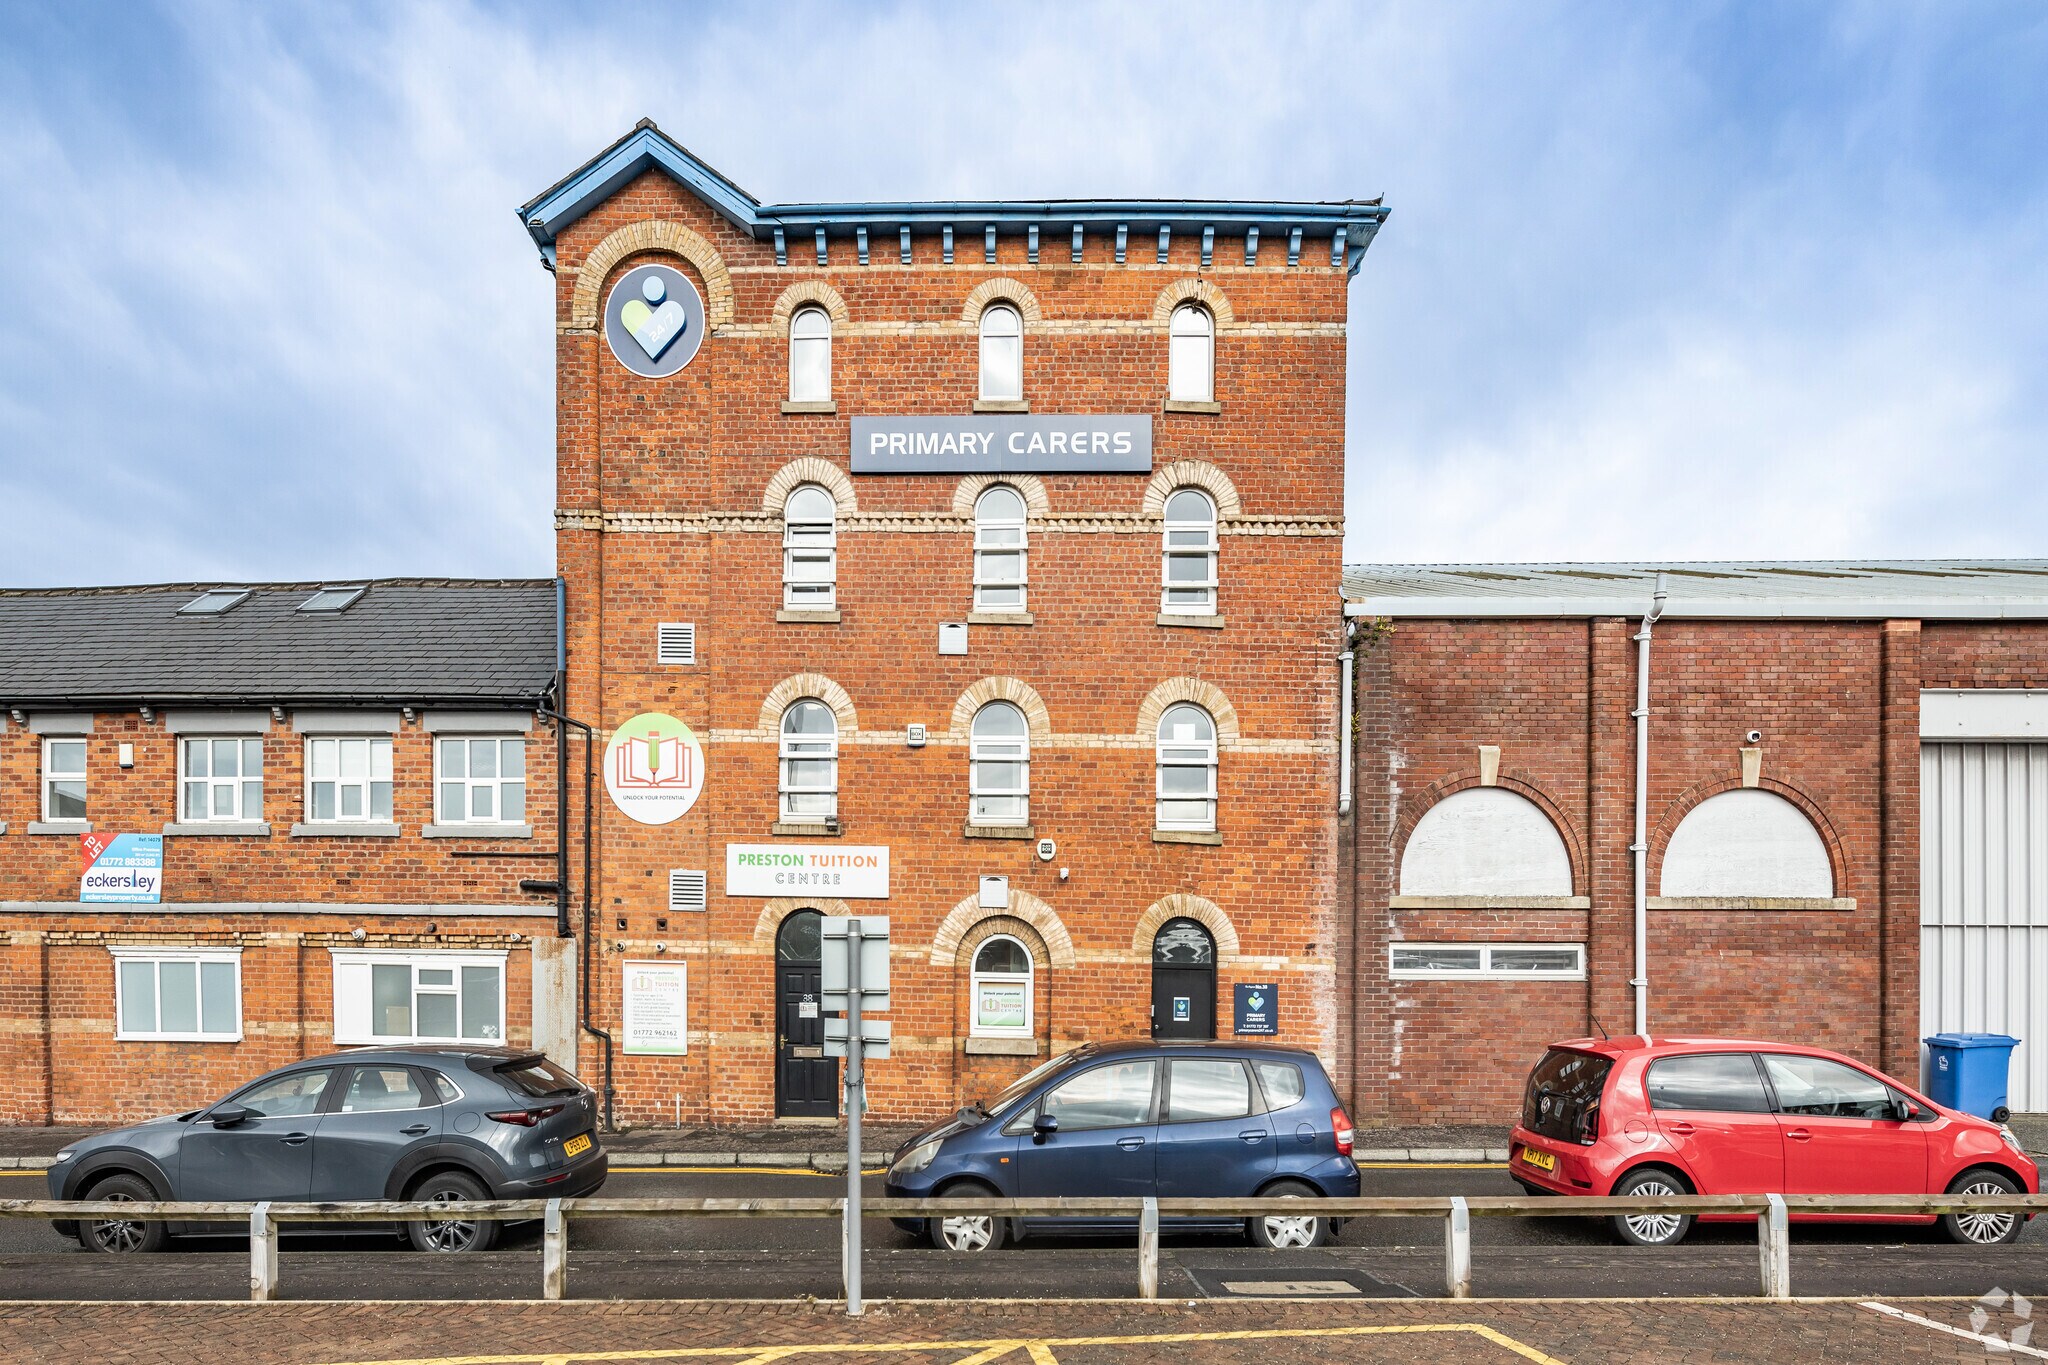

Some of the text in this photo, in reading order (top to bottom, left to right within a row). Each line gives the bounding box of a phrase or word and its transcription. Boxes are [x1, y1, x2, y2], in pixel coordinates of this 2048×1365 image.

[648, 311, 674, 343] 24/7
[870, 431, 1132, 455] PRIMARY CARERS
[84, 836, 96, 849] TO
[89, 841, 104, 859] LET
[100, 857, 123, 866] 01772
[738, 853, 877, 868] PRESTON TUITION
[86, 868, 155, 893] eckersley
[775, 872, 841, 885] CENTRE
[85, 893, 155, 902] eckersleyproperty.co.uk
[802, 993, 813, 1003] 38
